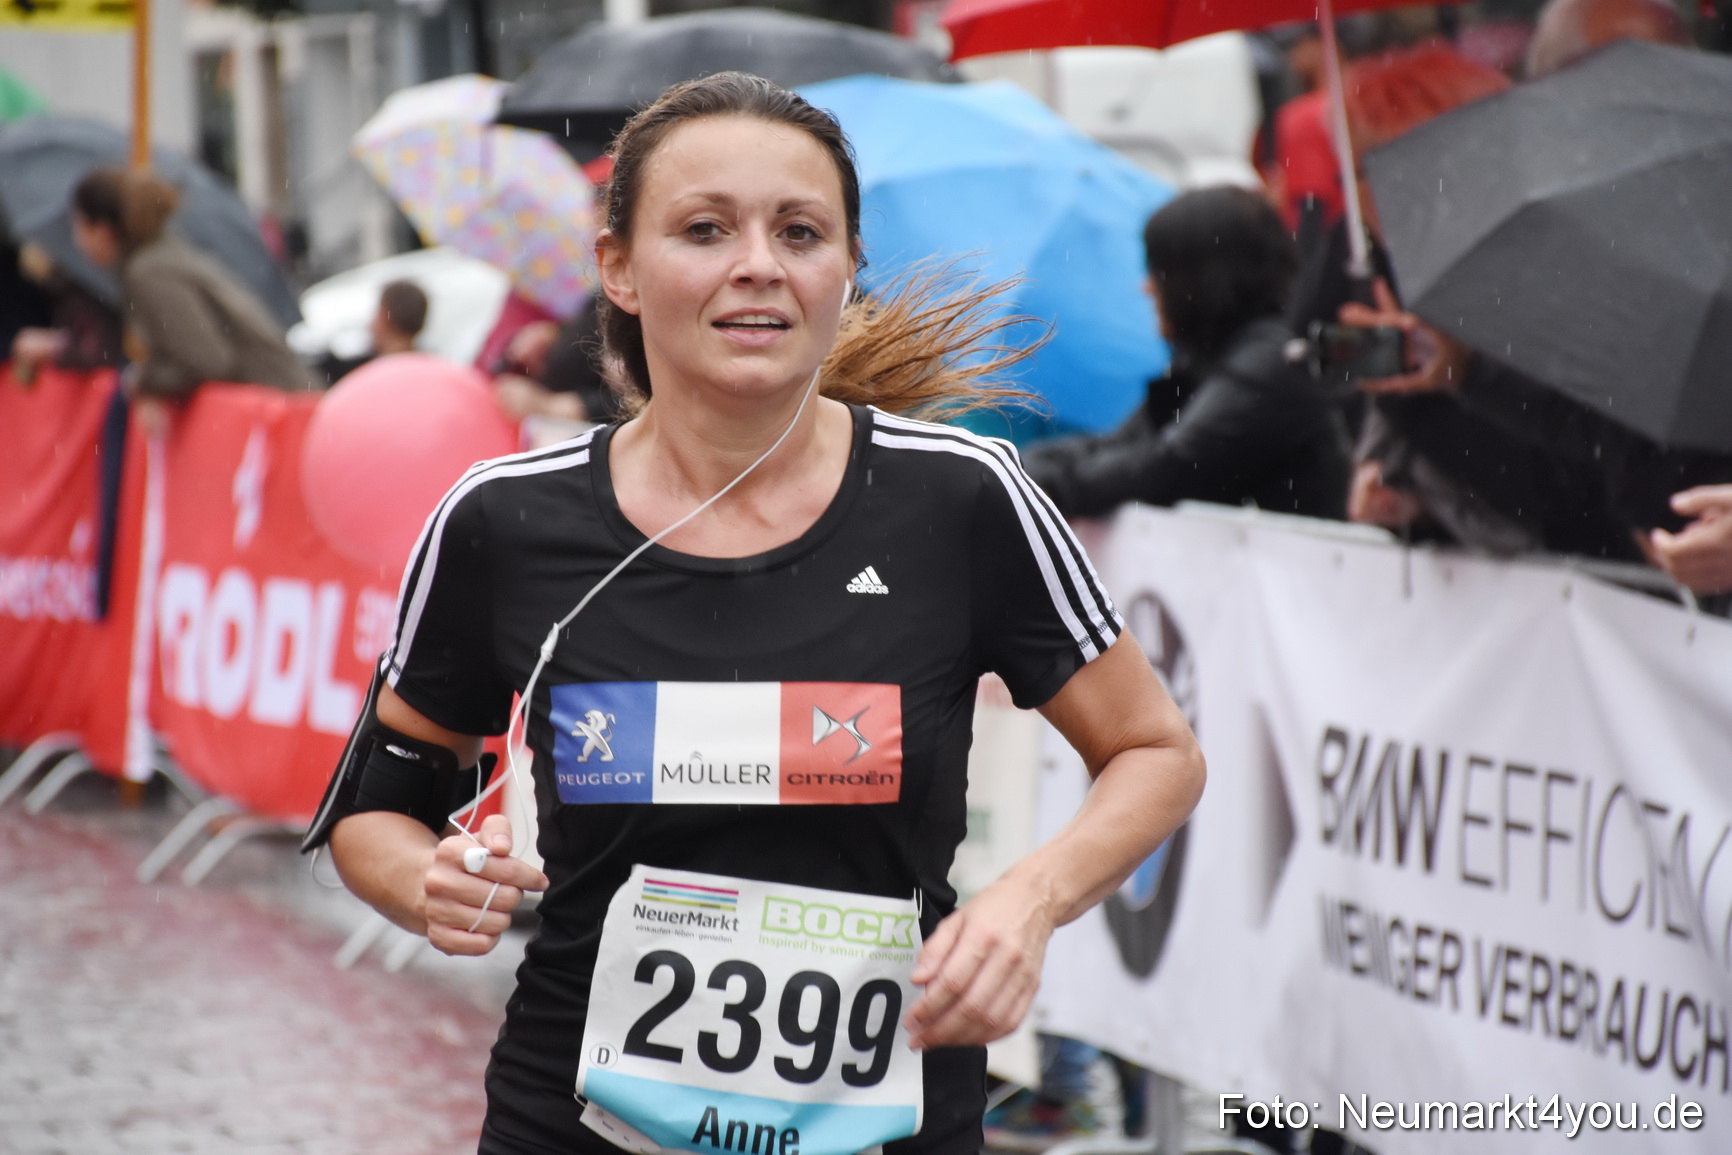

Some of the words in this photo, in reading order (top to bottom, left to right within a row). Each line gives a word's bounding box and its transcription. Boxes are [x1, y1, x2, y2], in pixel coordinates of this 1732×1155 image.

[846, 583, 889, 595] adidas
[558, 772, 646, 786] PEUGEOT
[1317, 727, 1448, 874] BMW
[633, 903, 740, 932] NeuerMarkt
[761, 896, 917, 948] BOCK
[758, 934, 808, 952] inspired
[811, 940, 825, 954] by
[829, 945, 865, 959] smart
[869, 950, 914, 964] concepts
[622, 949, 903, 1088] 2399
[1473, 937, 1732, 1093] VERBRAUCH
[597, 1047, 610, 1065] D
[691, 1105, 800, 1155] Anne
